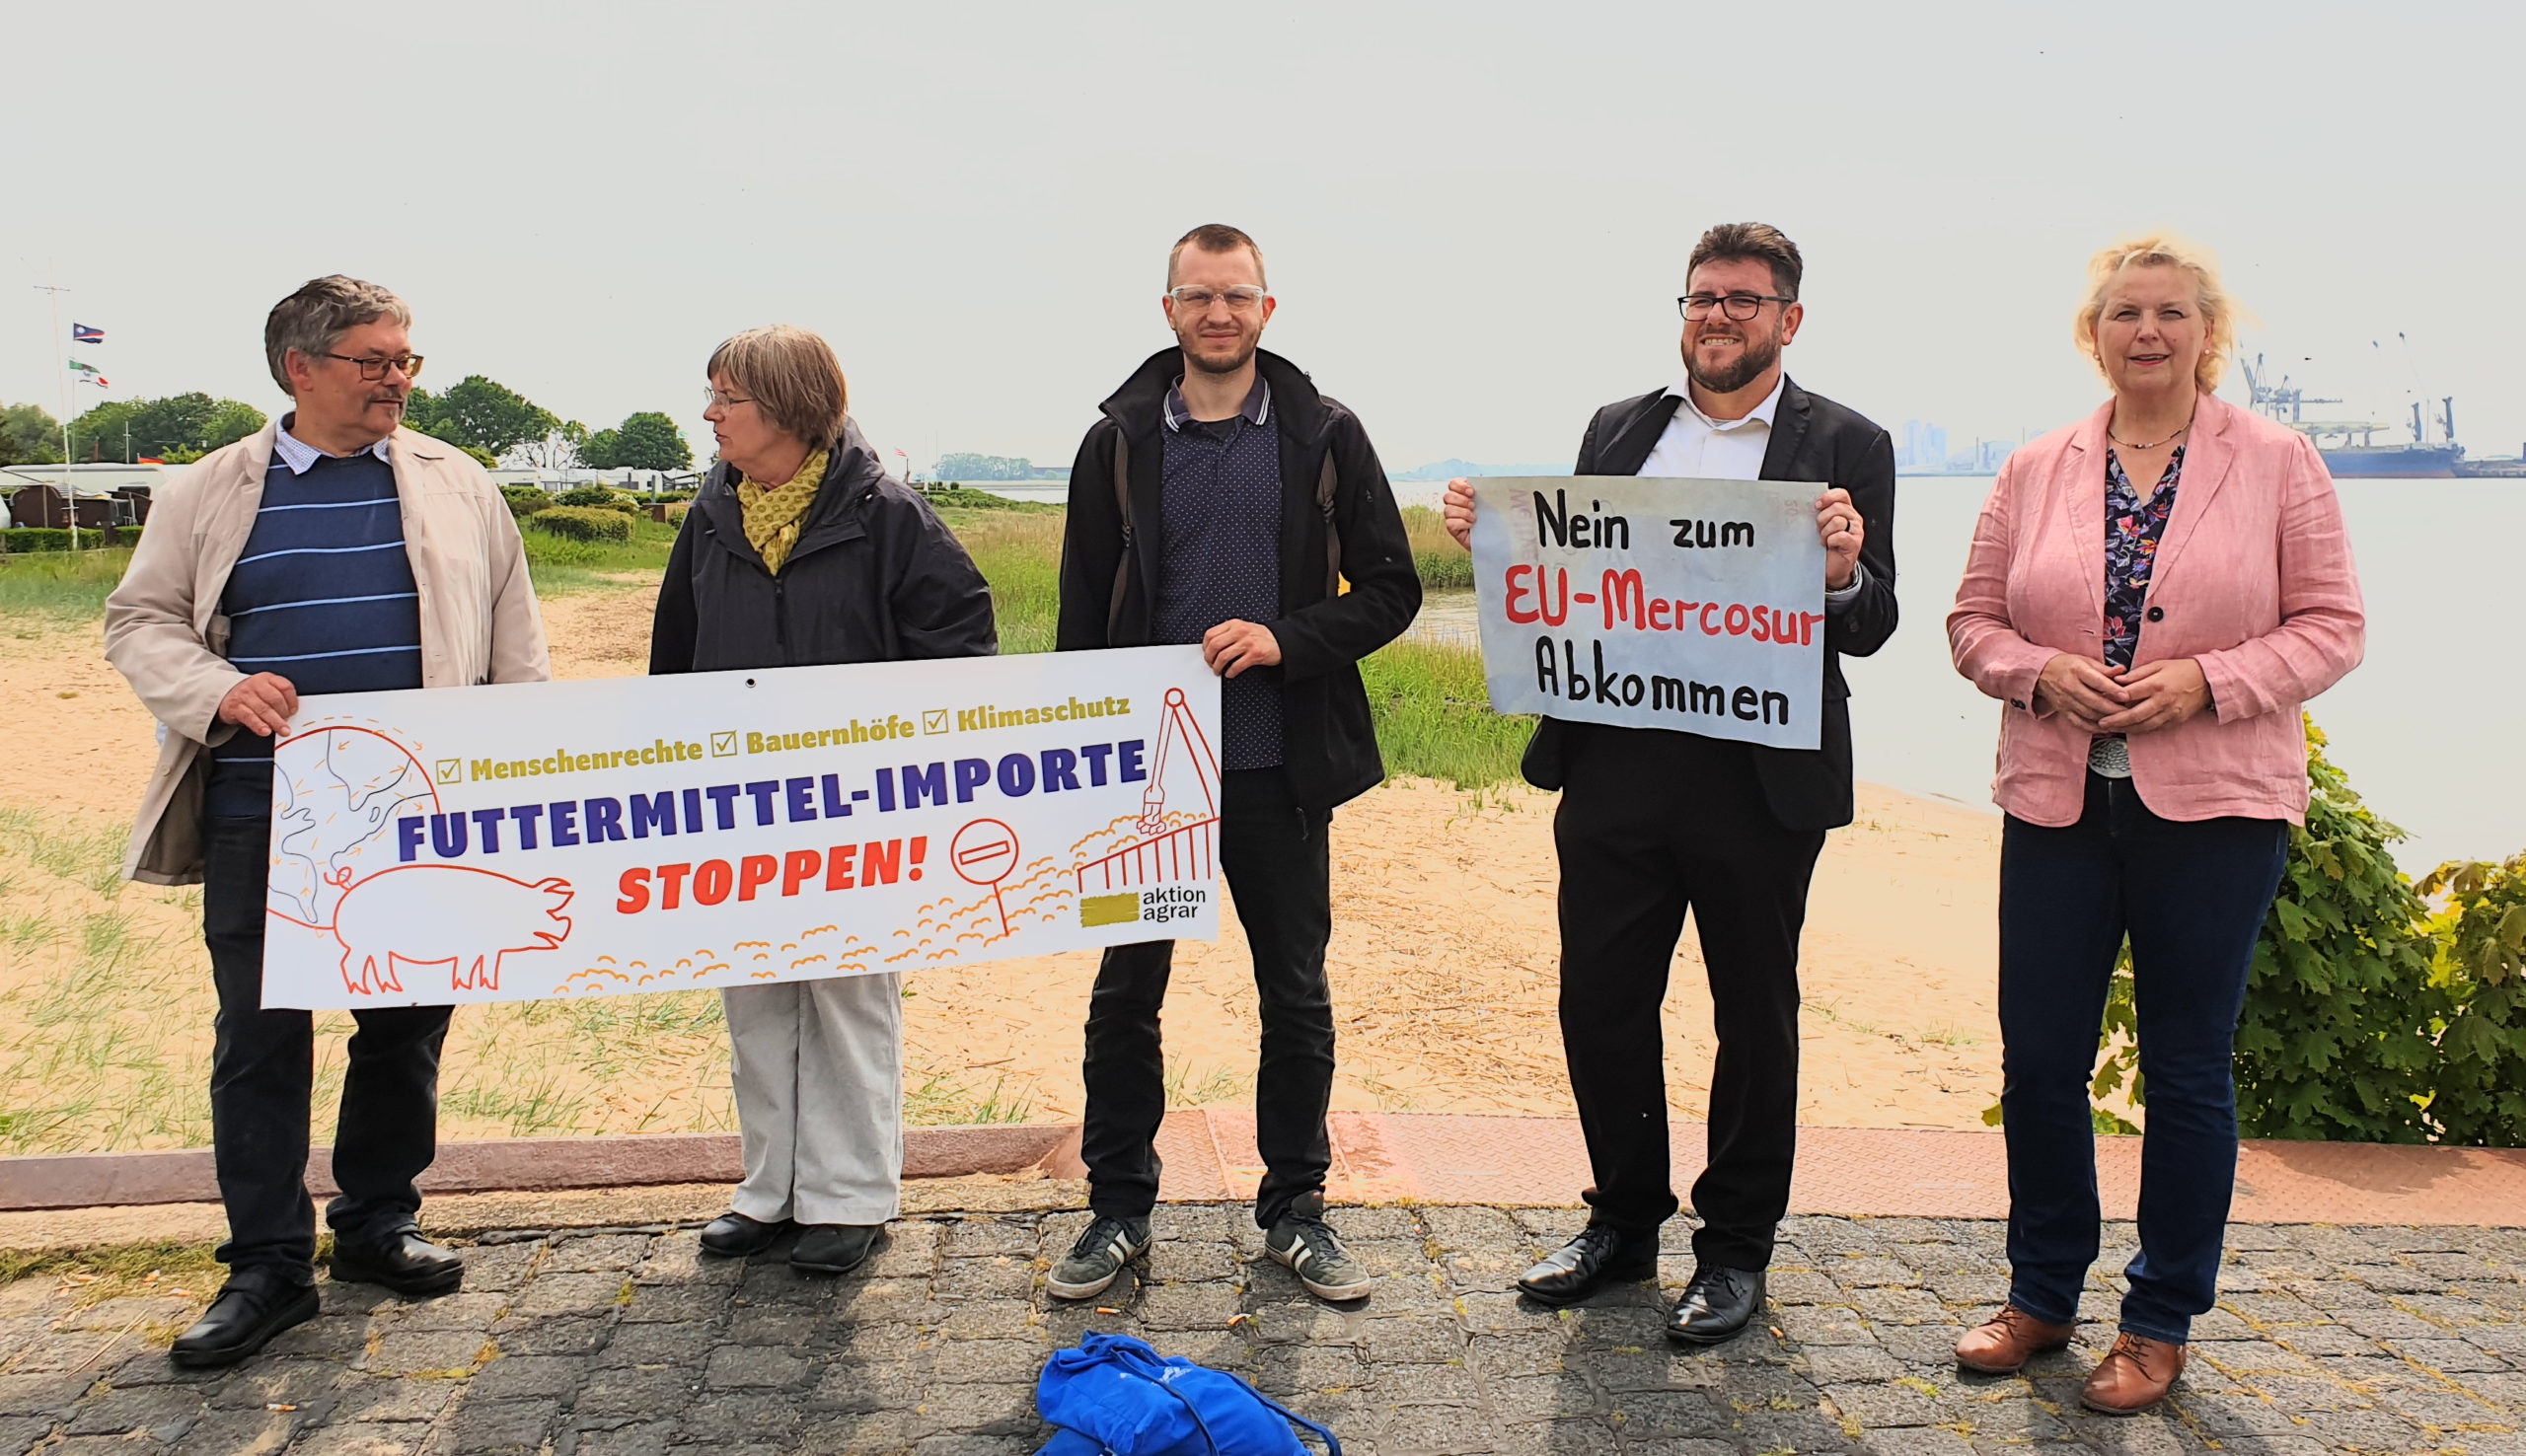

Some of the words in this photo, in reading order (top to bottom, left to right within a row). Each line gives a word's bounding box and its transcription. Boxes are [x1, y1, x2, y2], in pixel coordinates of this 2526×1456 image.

[1532, 487, 1630, 550] Nein
[1669, 518, 1756, 549] zum
[1505, 564, 1825, 646] EU-Mercosur
[1535, 634, 1789, 726] Abkommen
[470, 738, 704, 782] Menschenrechte
[746, 714, 917, 755] Bauernhöfe
[957, 696, 1132, 733] Klimaschutz
[398, 739, 1148, 863] FUTTERMITTEL-IMPORTE
[617, 836, 929, 915] STOPPEN!
[1143, 886, 1207, 906] aktion
[1143, 904, 1199, 923] agrar
